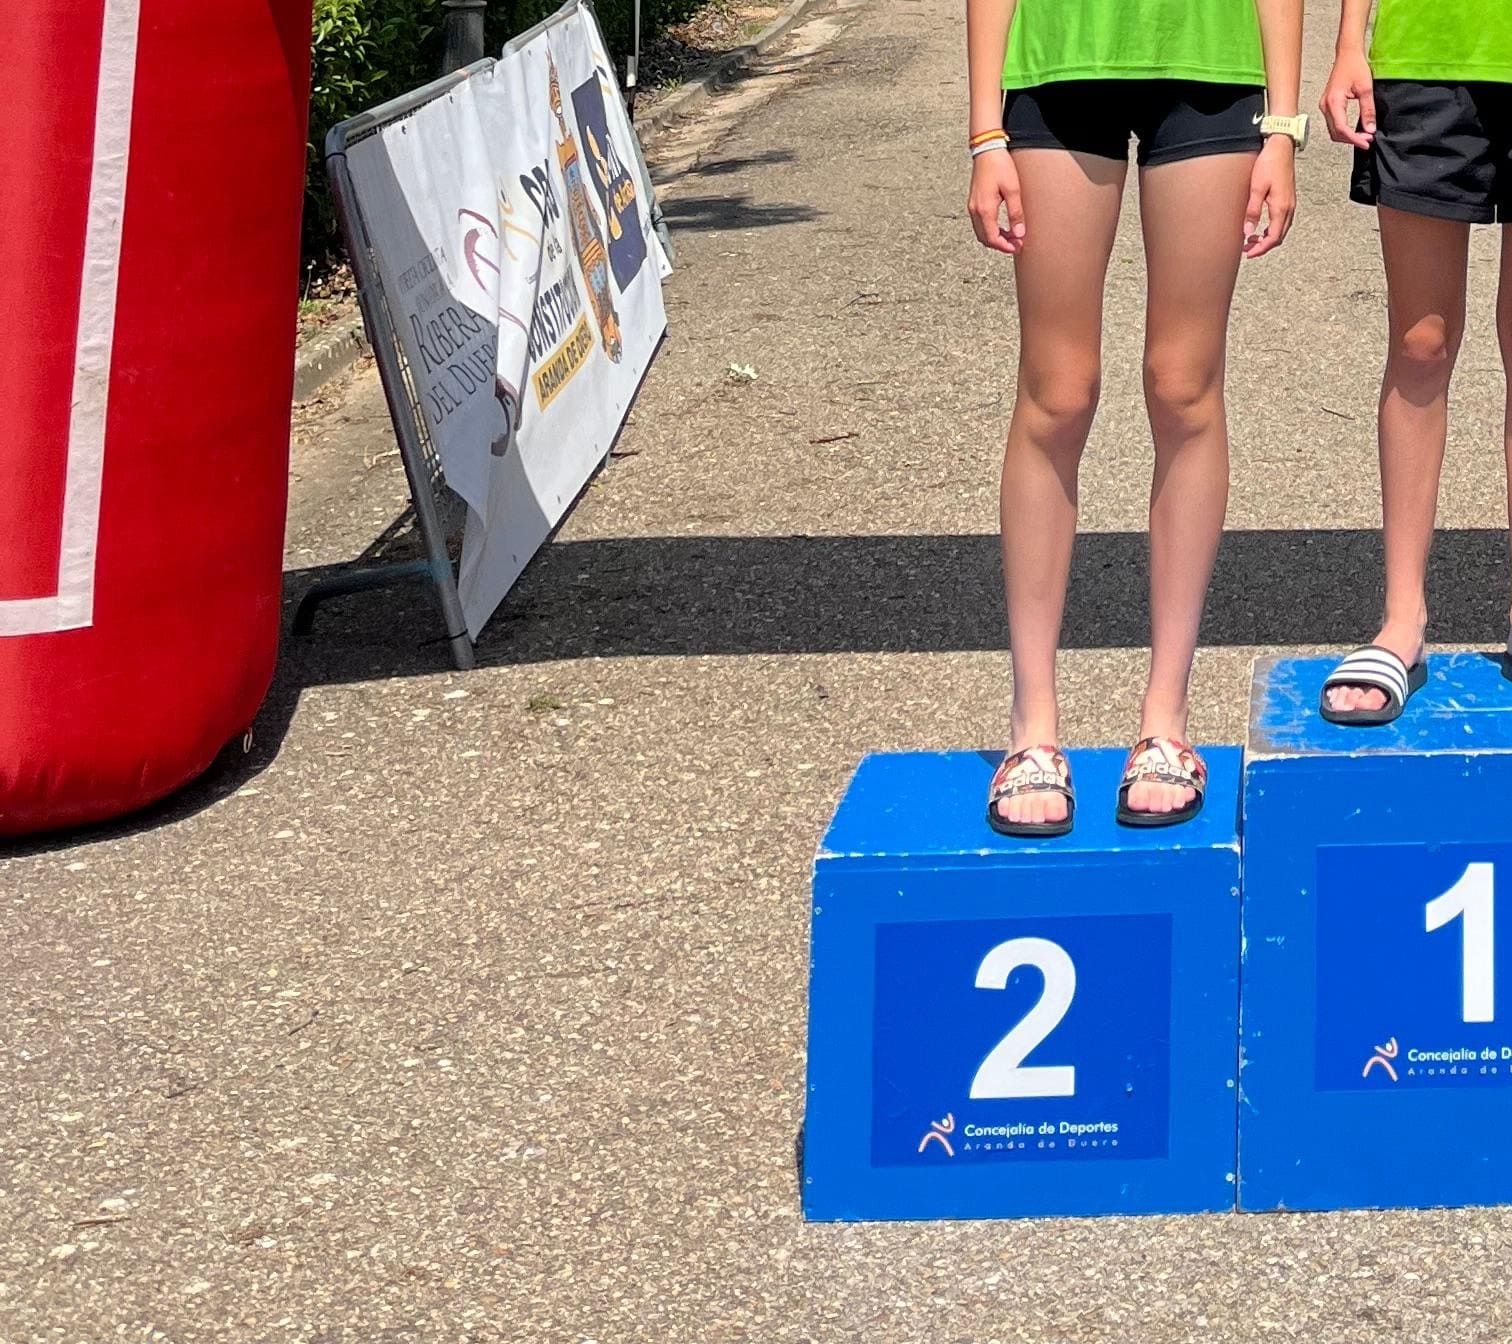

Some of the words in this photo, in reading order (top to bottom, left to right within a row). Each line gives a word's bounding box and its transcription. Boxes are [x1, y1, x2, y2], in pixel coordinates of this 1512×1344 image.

[1126, 761, 1192, 780] adidas
[1001, 770, 1066, 793] adidas
[1424, 861, 1495, 1023] 1
[968, 936, 1077, 1100] 2
[1408, 1047, 1476, 1063] Concejalía
[1480, 1047, 1497, 1060] de
[1408, 1065, 1468, 1076] Aranda
[1480, 1065, 1497, 1075] de
[964, 1123, 1035, 1138] Concejalía
[1038, 1122, 1055, 1135] de
[1059, 1121, 1119, 1136] Deportes
[964, 1140, 1025, 1151] Aranda
[1038, 1139, 1055, 1149] de
